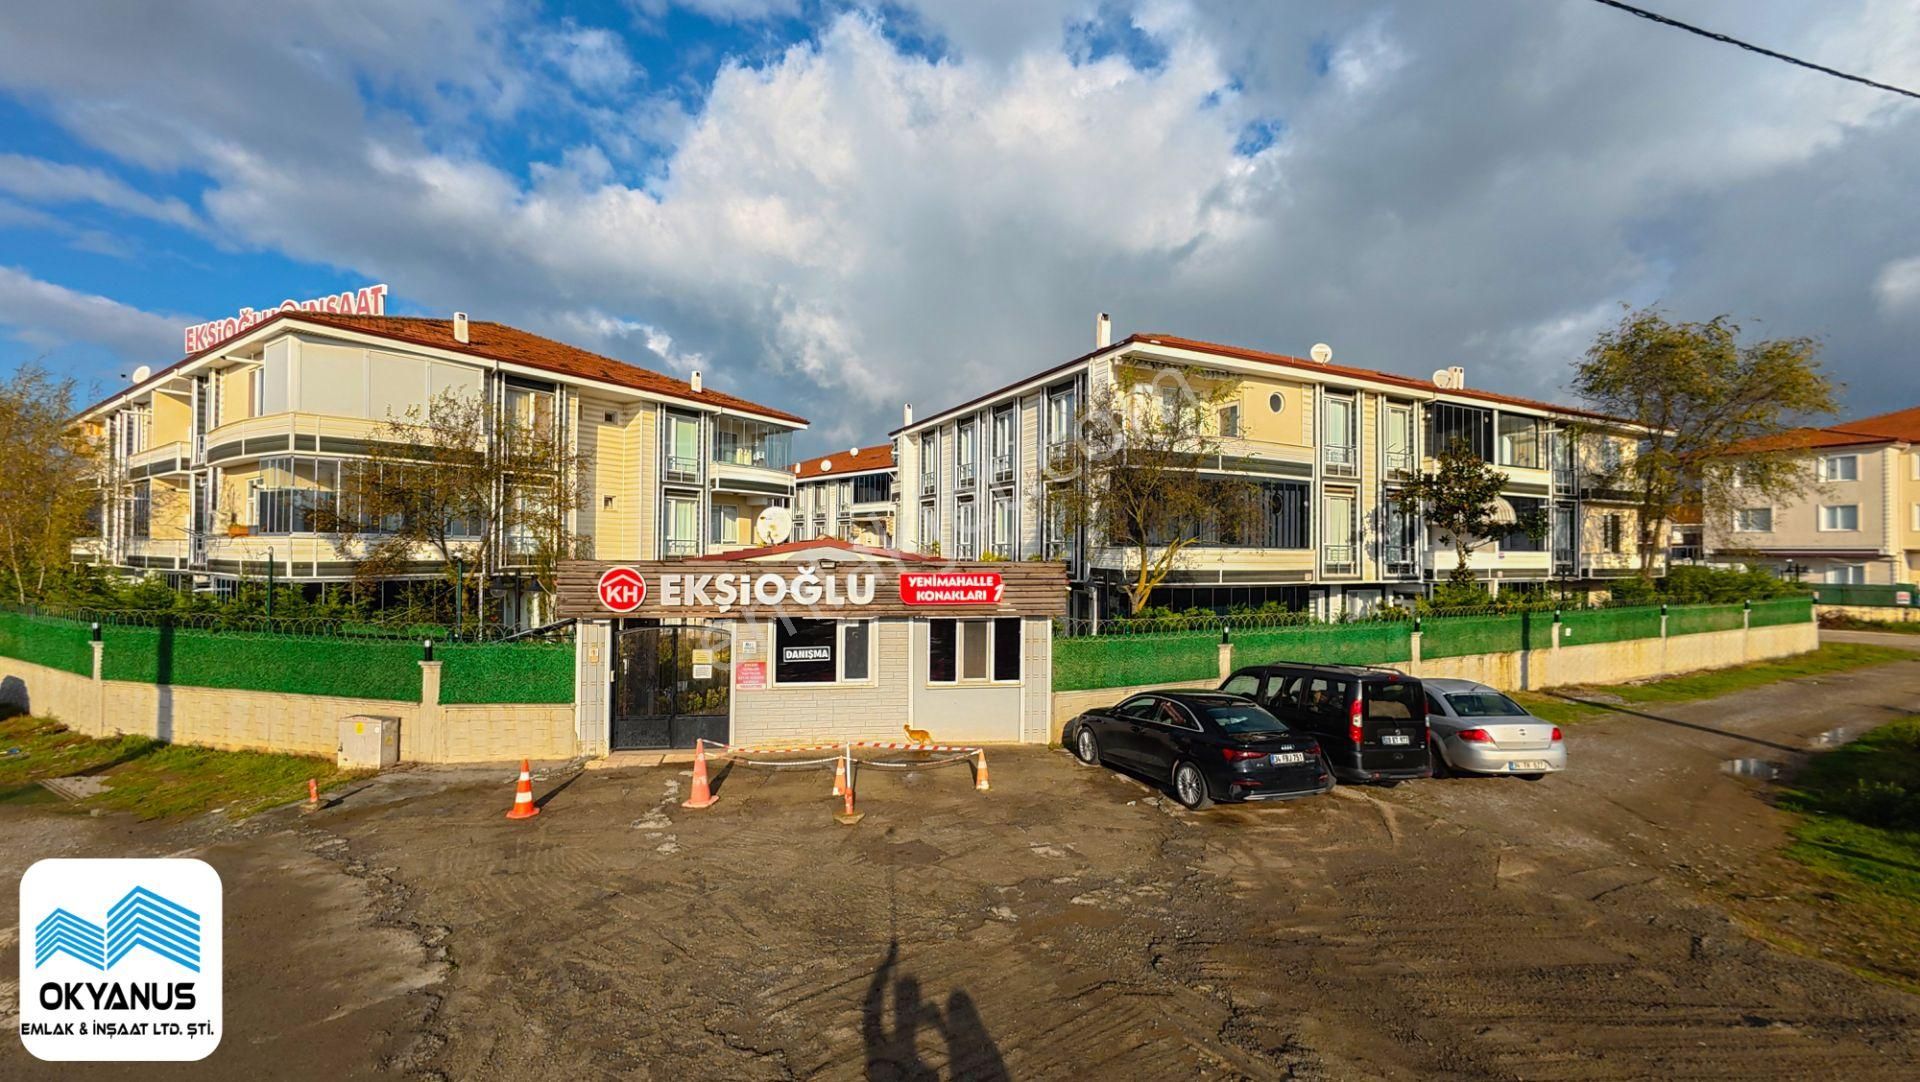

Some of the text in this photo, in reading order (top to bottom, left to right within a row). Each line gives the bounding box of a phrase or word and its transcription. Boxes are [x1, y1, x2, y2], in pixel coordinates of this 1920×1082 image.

[908, 575, 994, 587] YENİMAHALLE
[606, 585, 639, 603] KH
[916, 583, 1004, 602] KONAKLARI 1
[785, 649, 828, 659] DANIŞMA
